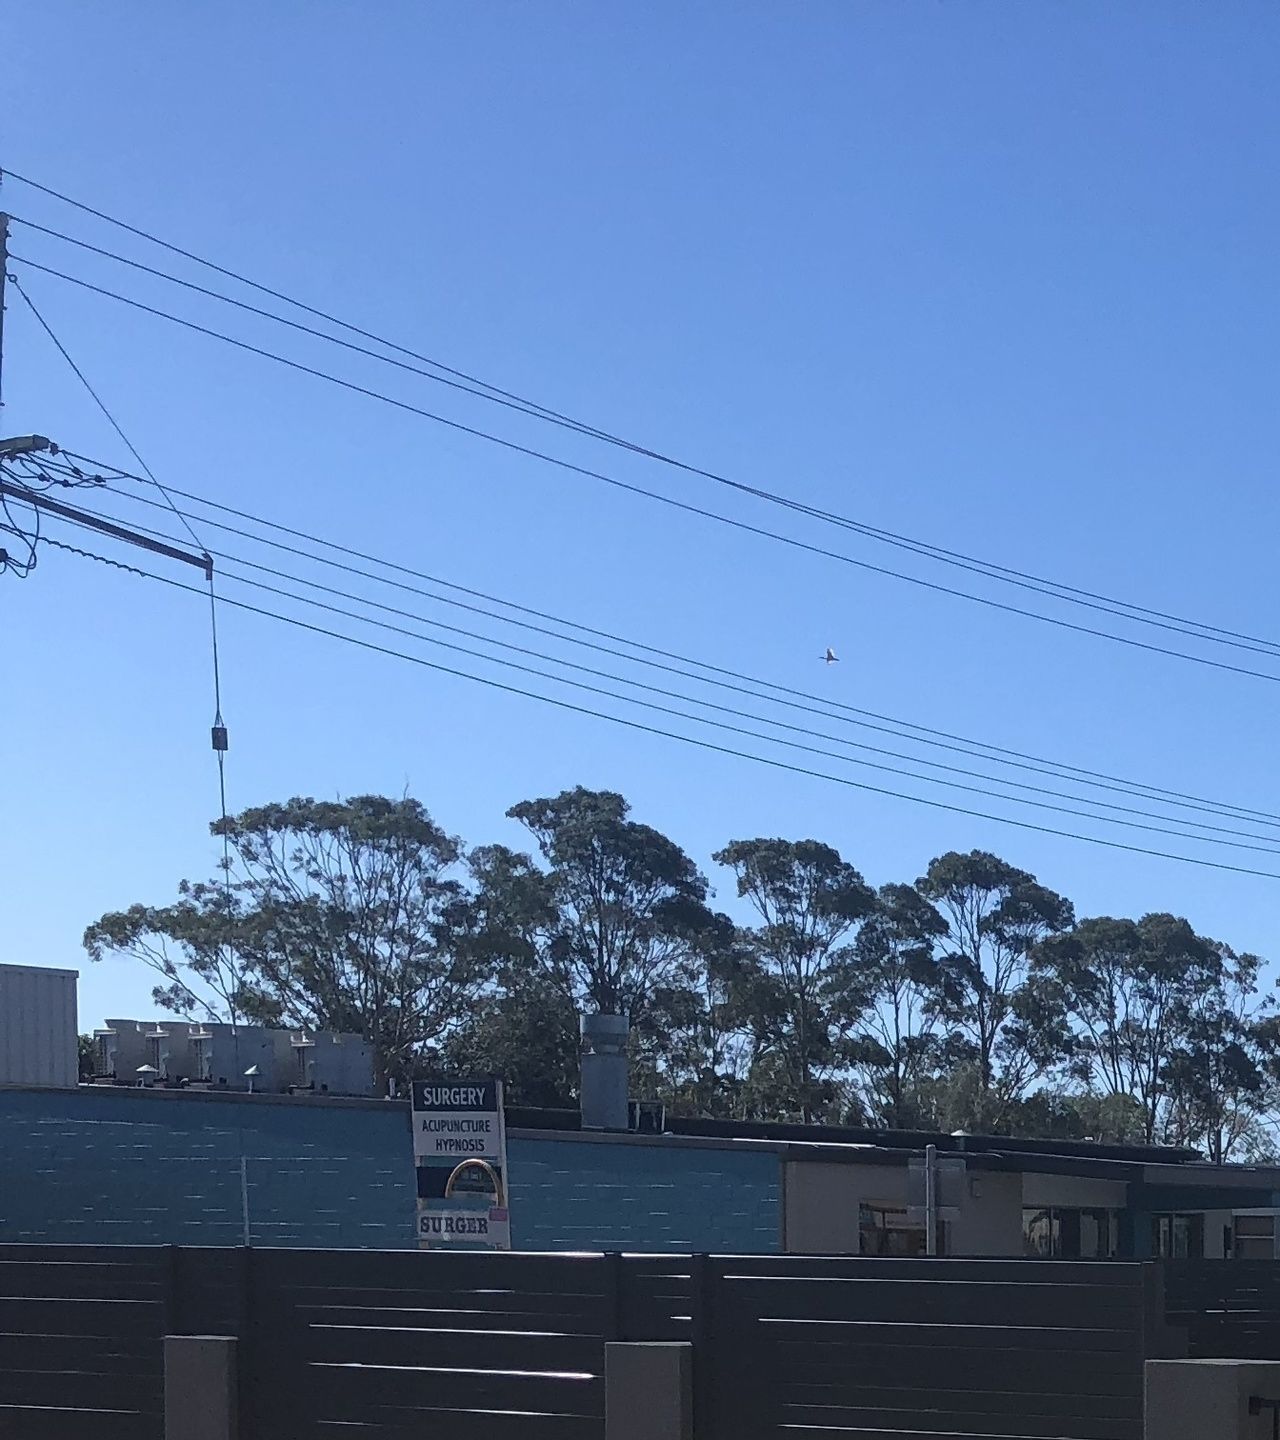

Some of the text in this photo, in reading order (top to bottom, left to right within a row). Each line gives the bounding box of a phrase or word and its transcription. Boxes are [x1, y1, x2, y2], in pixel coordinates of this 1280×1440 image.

[423, 1087, 486, 1106] SURGERY
[422, 1119, 491, 1133] ACUPUNCTURE
[435, 1138, 486, 1152] HYPNOSIS
